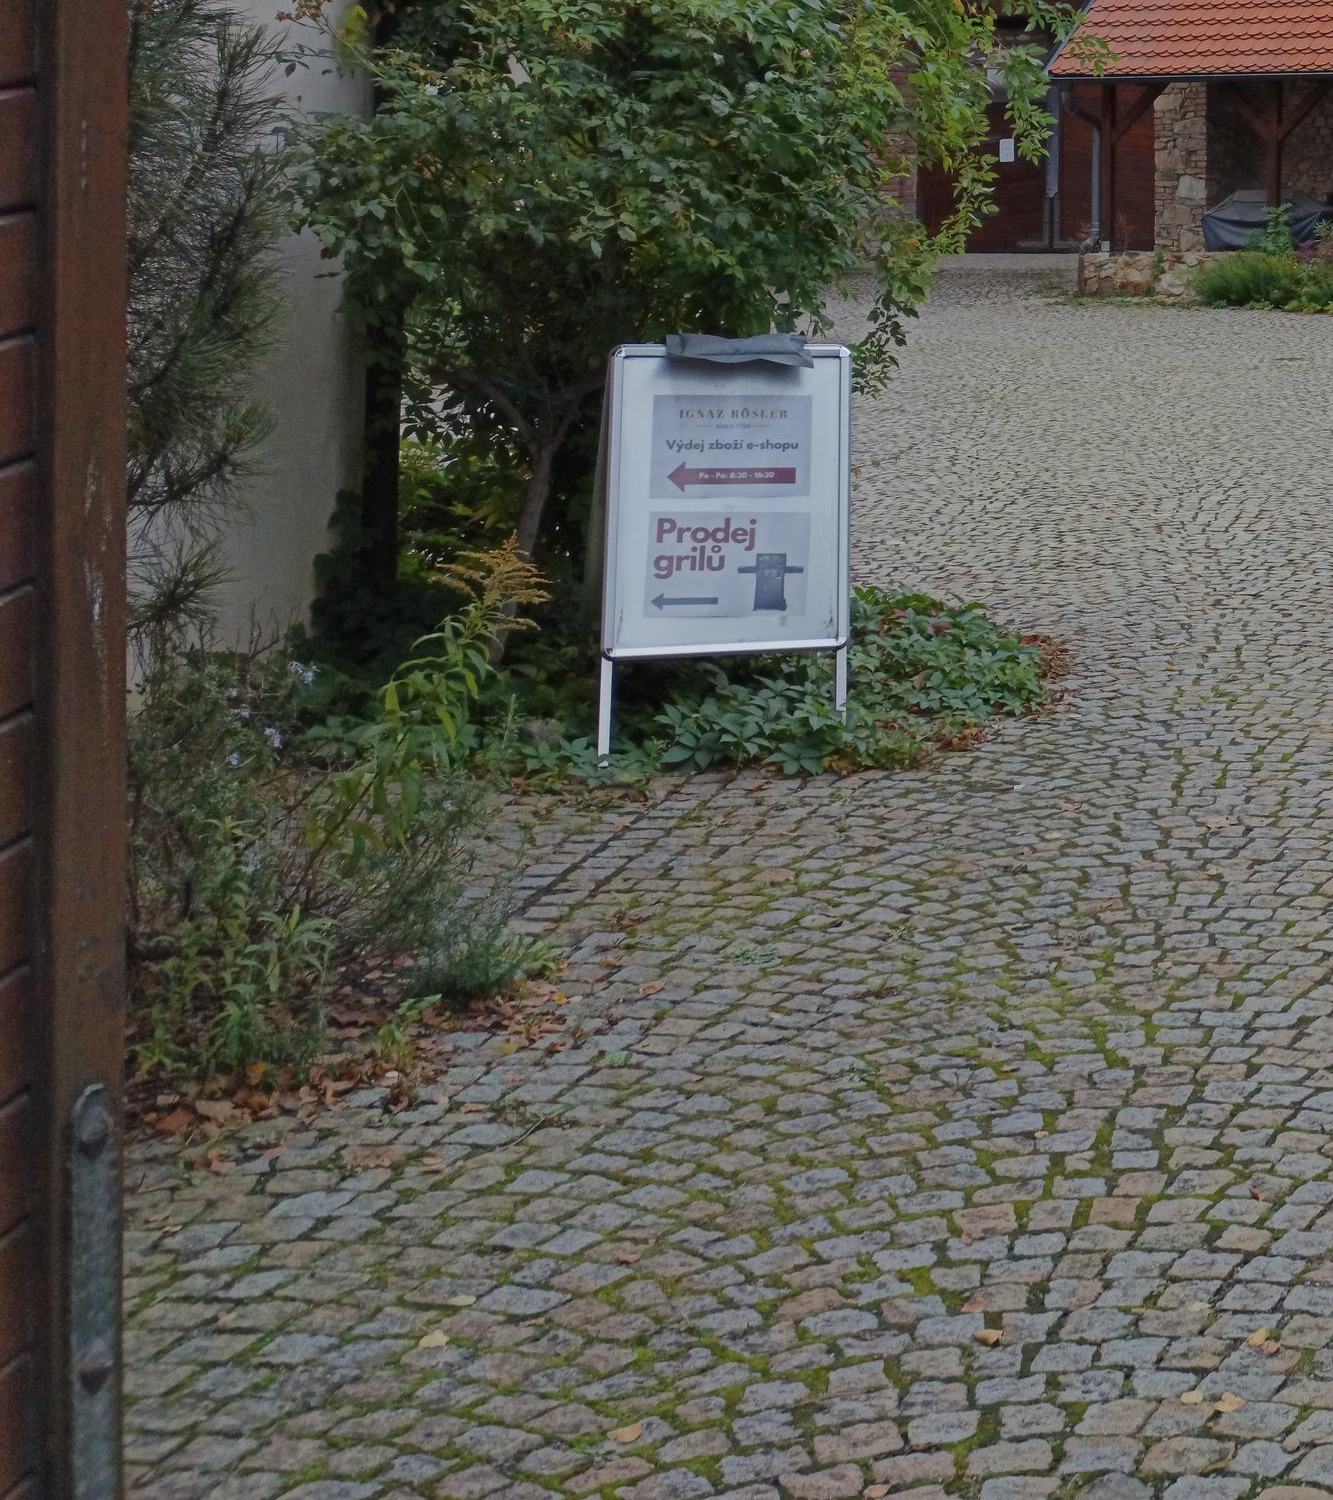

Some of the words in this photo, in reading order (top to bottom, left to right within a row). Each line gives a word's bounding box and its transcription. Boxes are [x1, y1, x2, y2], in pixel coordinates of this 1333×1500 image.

[679, 409, 725, 419] IGNAZ
[731, 406, 788, 419] RÖSLER
[666, 440, 705, 453] Výdej
[708, 438, 744, 450] zboží
[746, 439, 799, 452] e-shopu
[656, 517, 757, 551] Prodej
[653, 545, 725, 580] grilů
